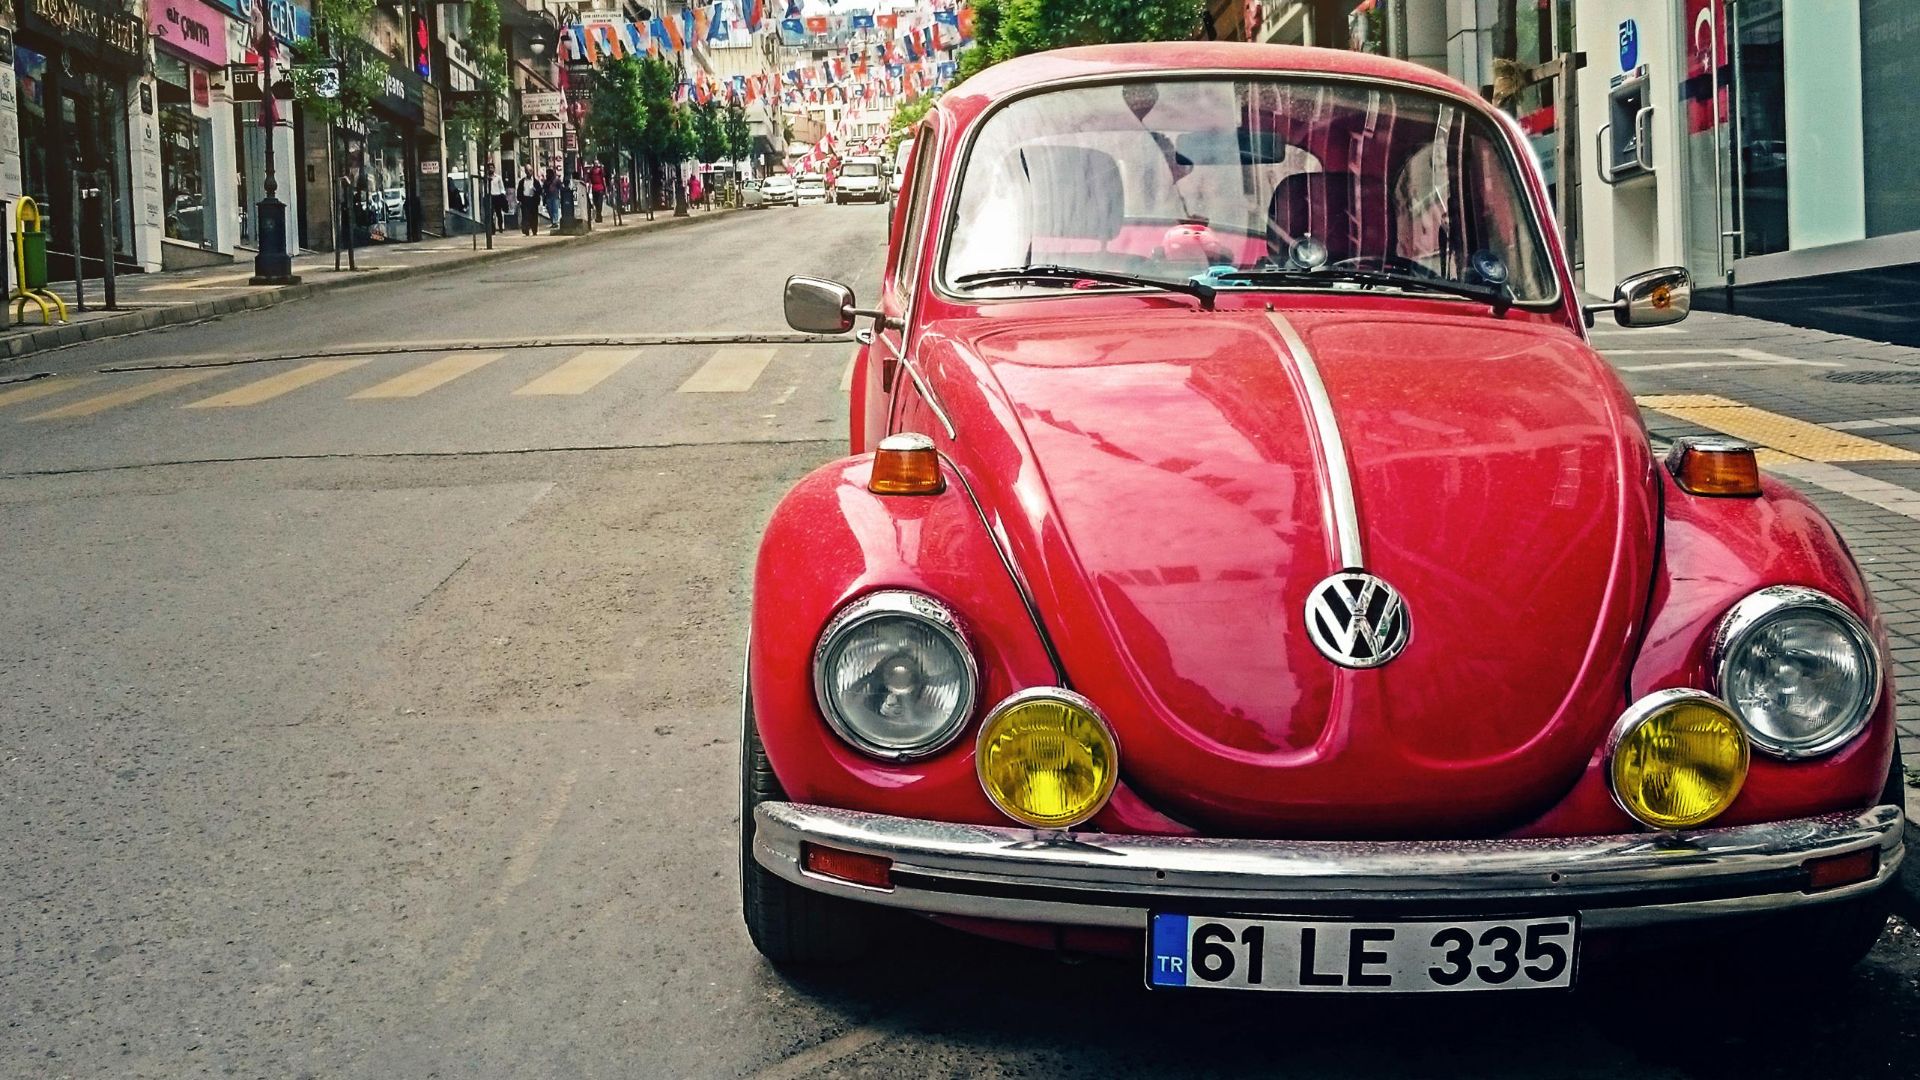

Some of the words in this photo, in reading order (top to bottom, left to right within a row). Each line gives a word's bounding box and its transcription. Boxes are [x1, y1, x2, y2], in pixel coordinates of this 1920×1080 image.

[1157, 955, 1184, 973] TR
[1191, 922, 1265, 984] 61
[1299, 927, 1396, 986] LE
[1428, 922, 1570, 986] 335
